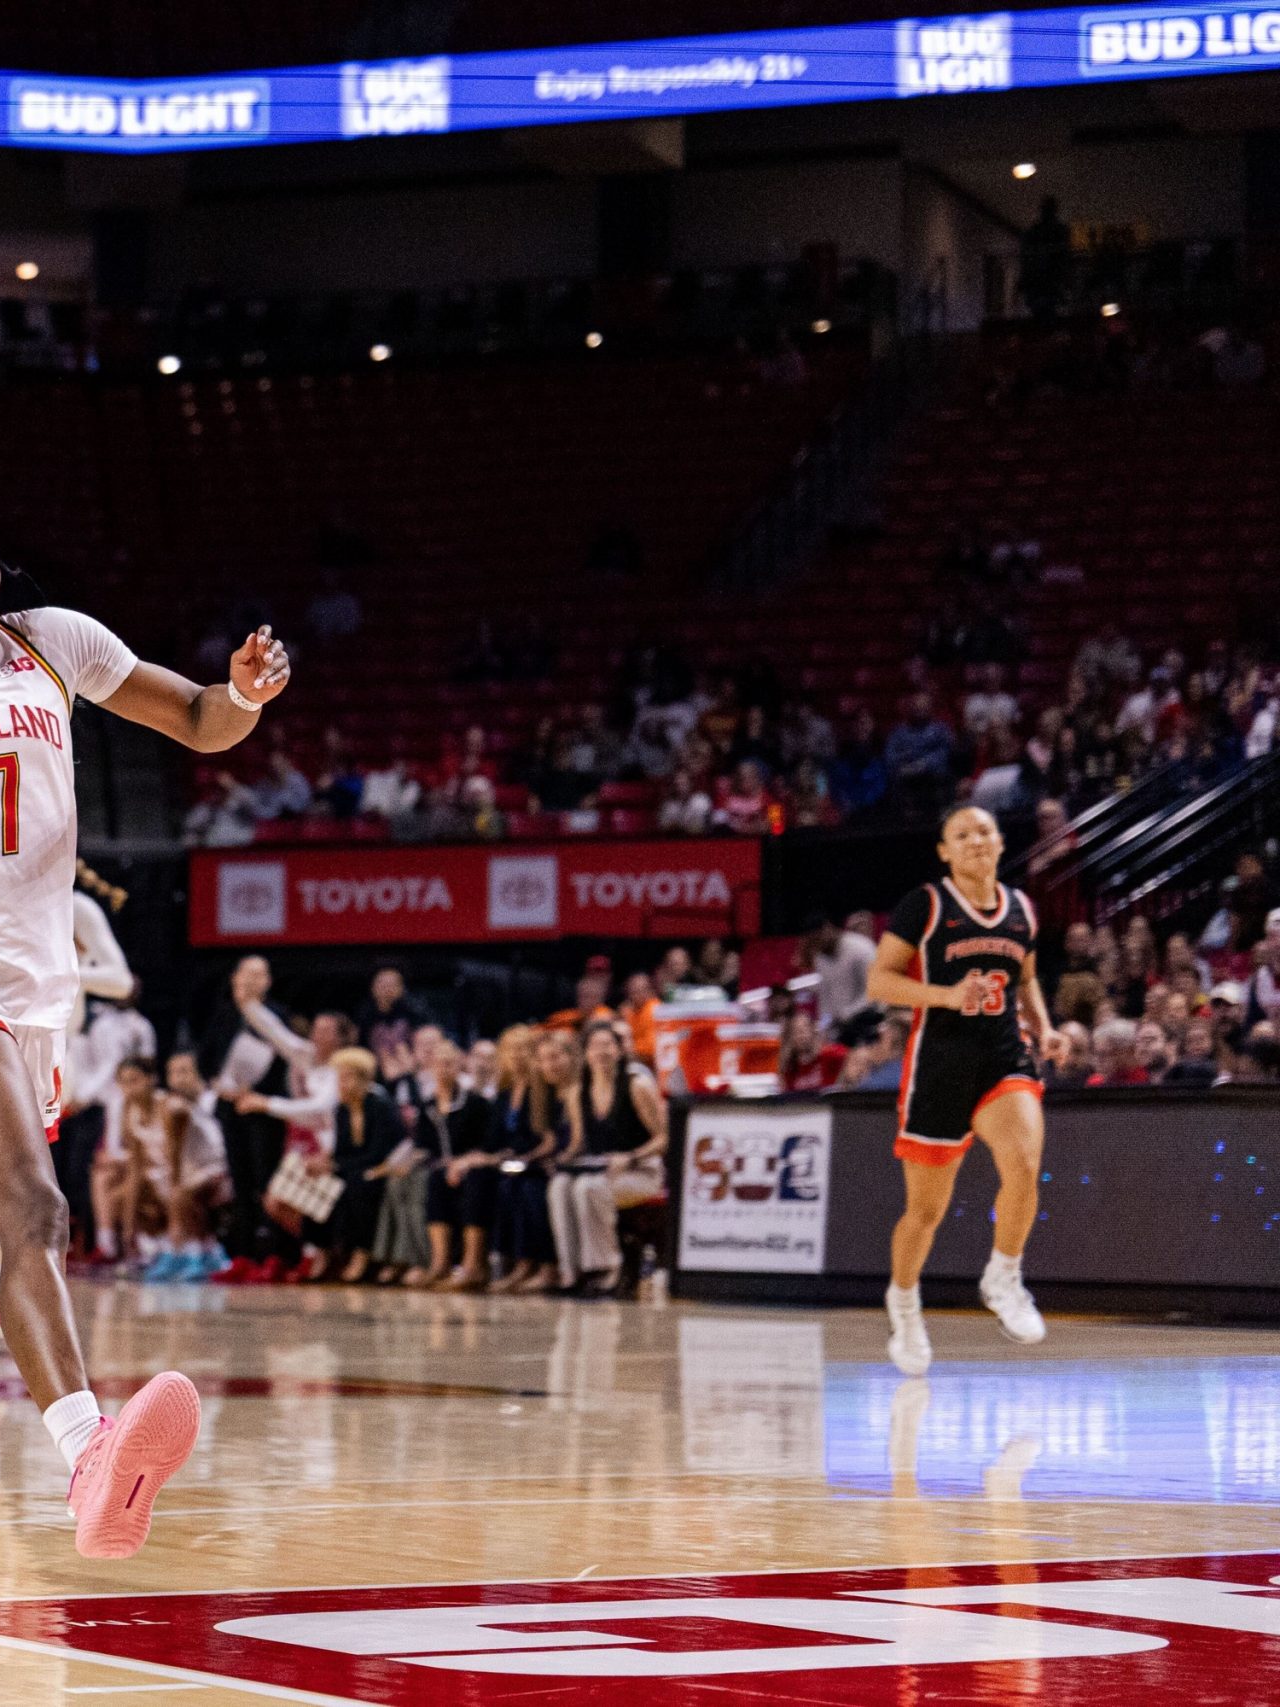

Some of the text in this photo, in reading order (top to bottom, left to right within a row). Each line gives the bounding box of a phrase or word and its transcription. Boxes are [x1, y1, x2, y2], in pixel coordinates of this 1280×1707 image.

[1090, 19, 1200, 63] BUD
[534, 69, 606, 101] Enjoy
[608, 60, 758, 96] Responsibly
[908, 58, 1009, 94] LIGHT
[20, 90, 259, 135] BUD LIGHT
[349, 99, 446, 136] LIGHT
[298, 876, 453, 913] TOYOTA
[571, 870, 731, 908] TOYOTA
